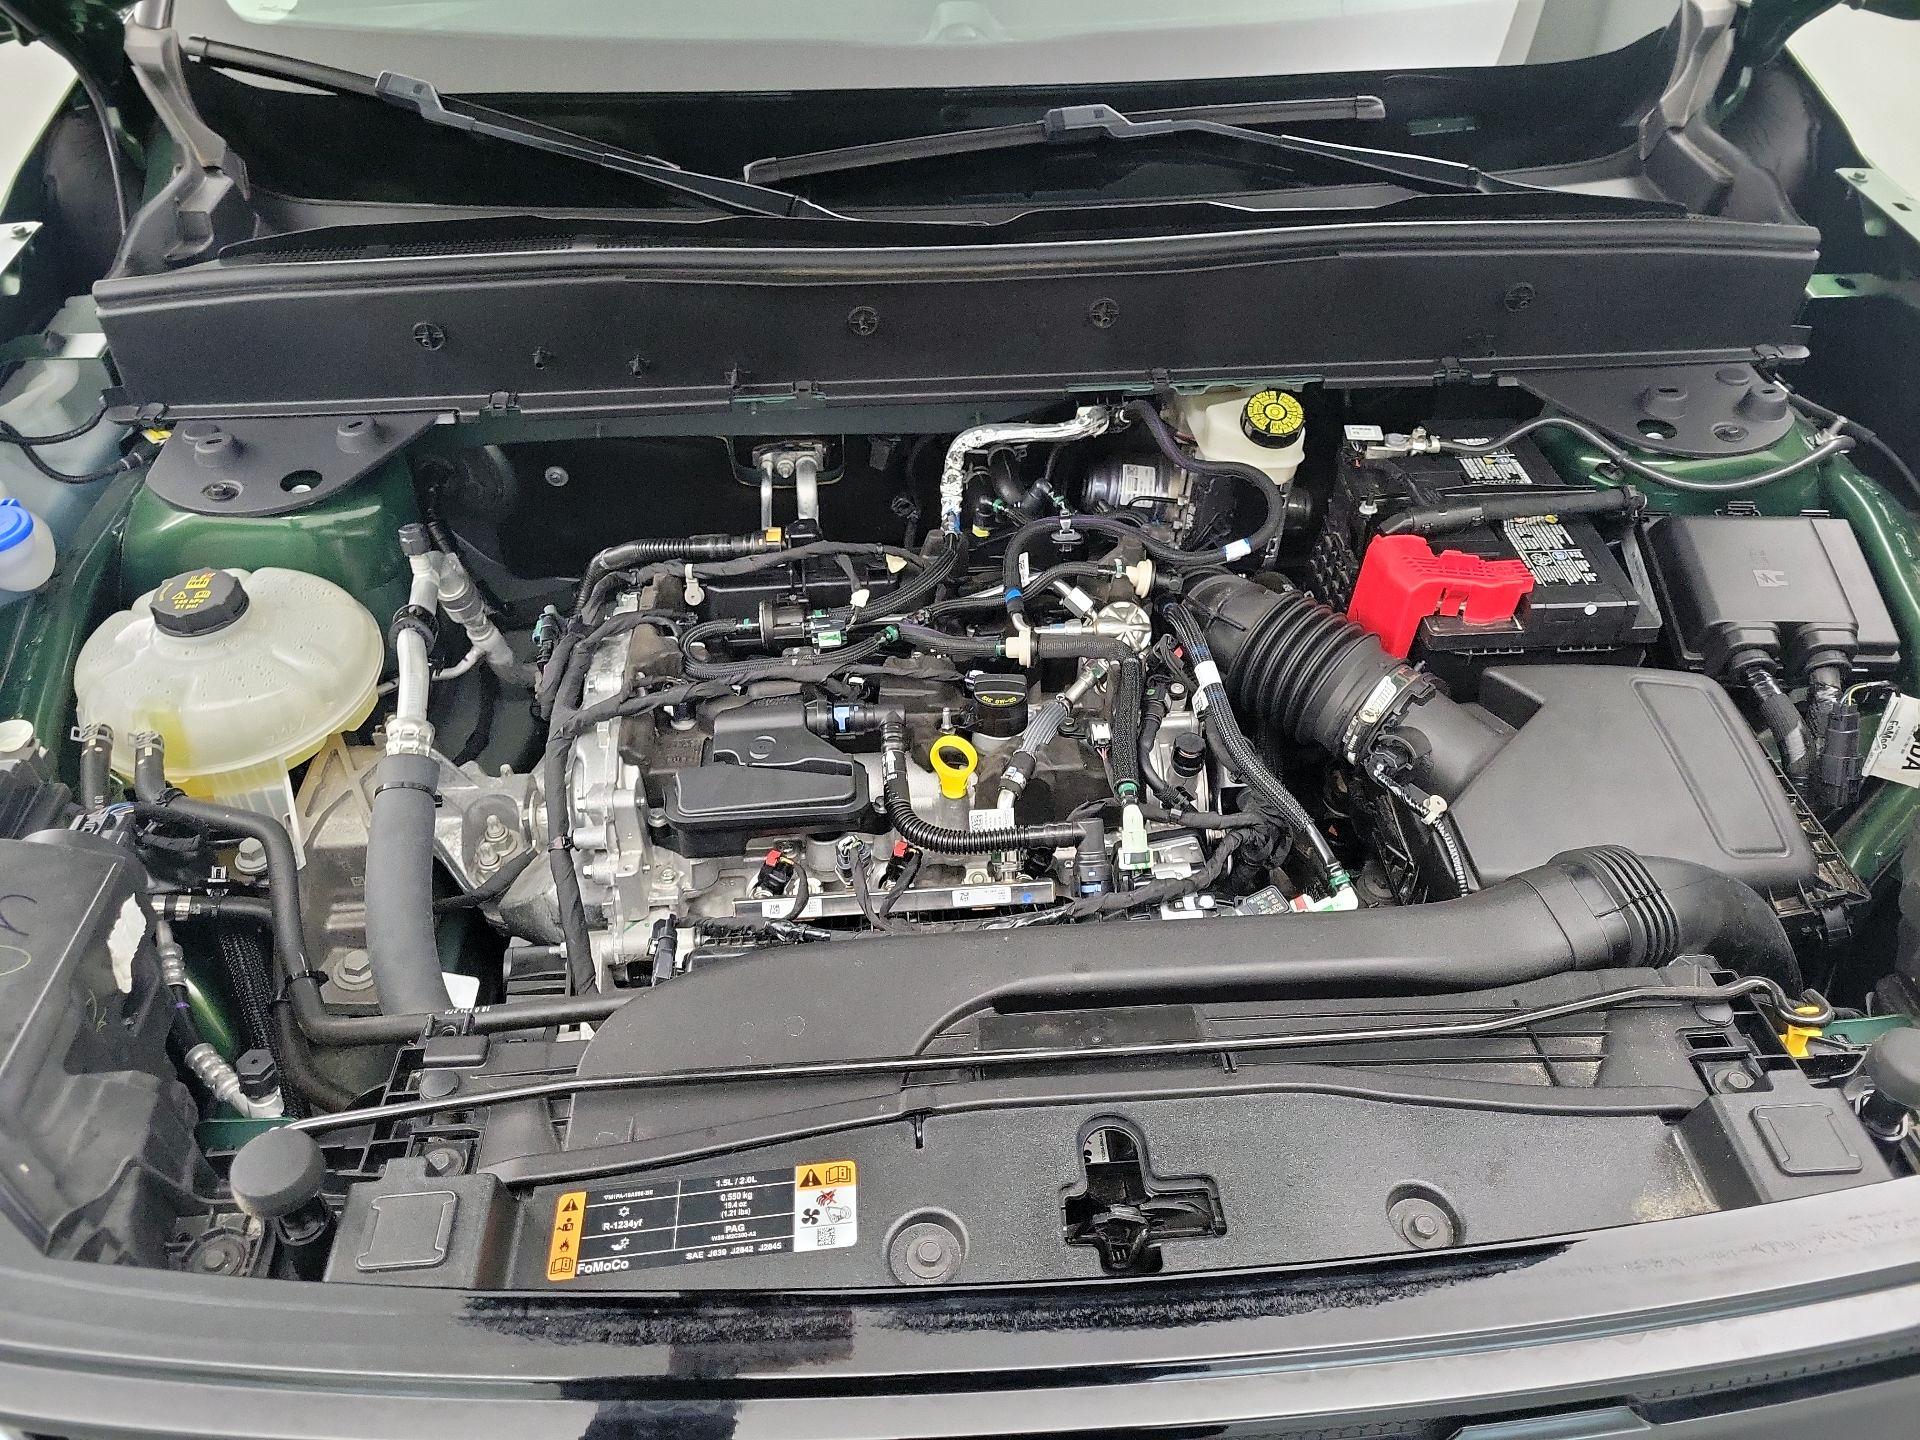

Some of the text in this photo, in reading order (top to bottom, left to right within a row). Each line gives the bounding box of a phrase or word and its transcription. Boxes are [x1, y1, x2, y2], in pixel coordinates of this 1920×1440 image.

[716, 1178, 733, 1187] 1.5L
[739, 1175, 758, 1184] 2.0L
[743, 1191, 753, 1201] kg
[738, 1208, 751, 1216] lbs)
[602, 1218, 644, 1231] R-1234yf
[724, 1224, 745, 1233] PAG
[685, 1251, 704, 1260] SAE
[707, 1248, 727, 1257] J639
[577, 1259, 629, 1275] FoMoCo
